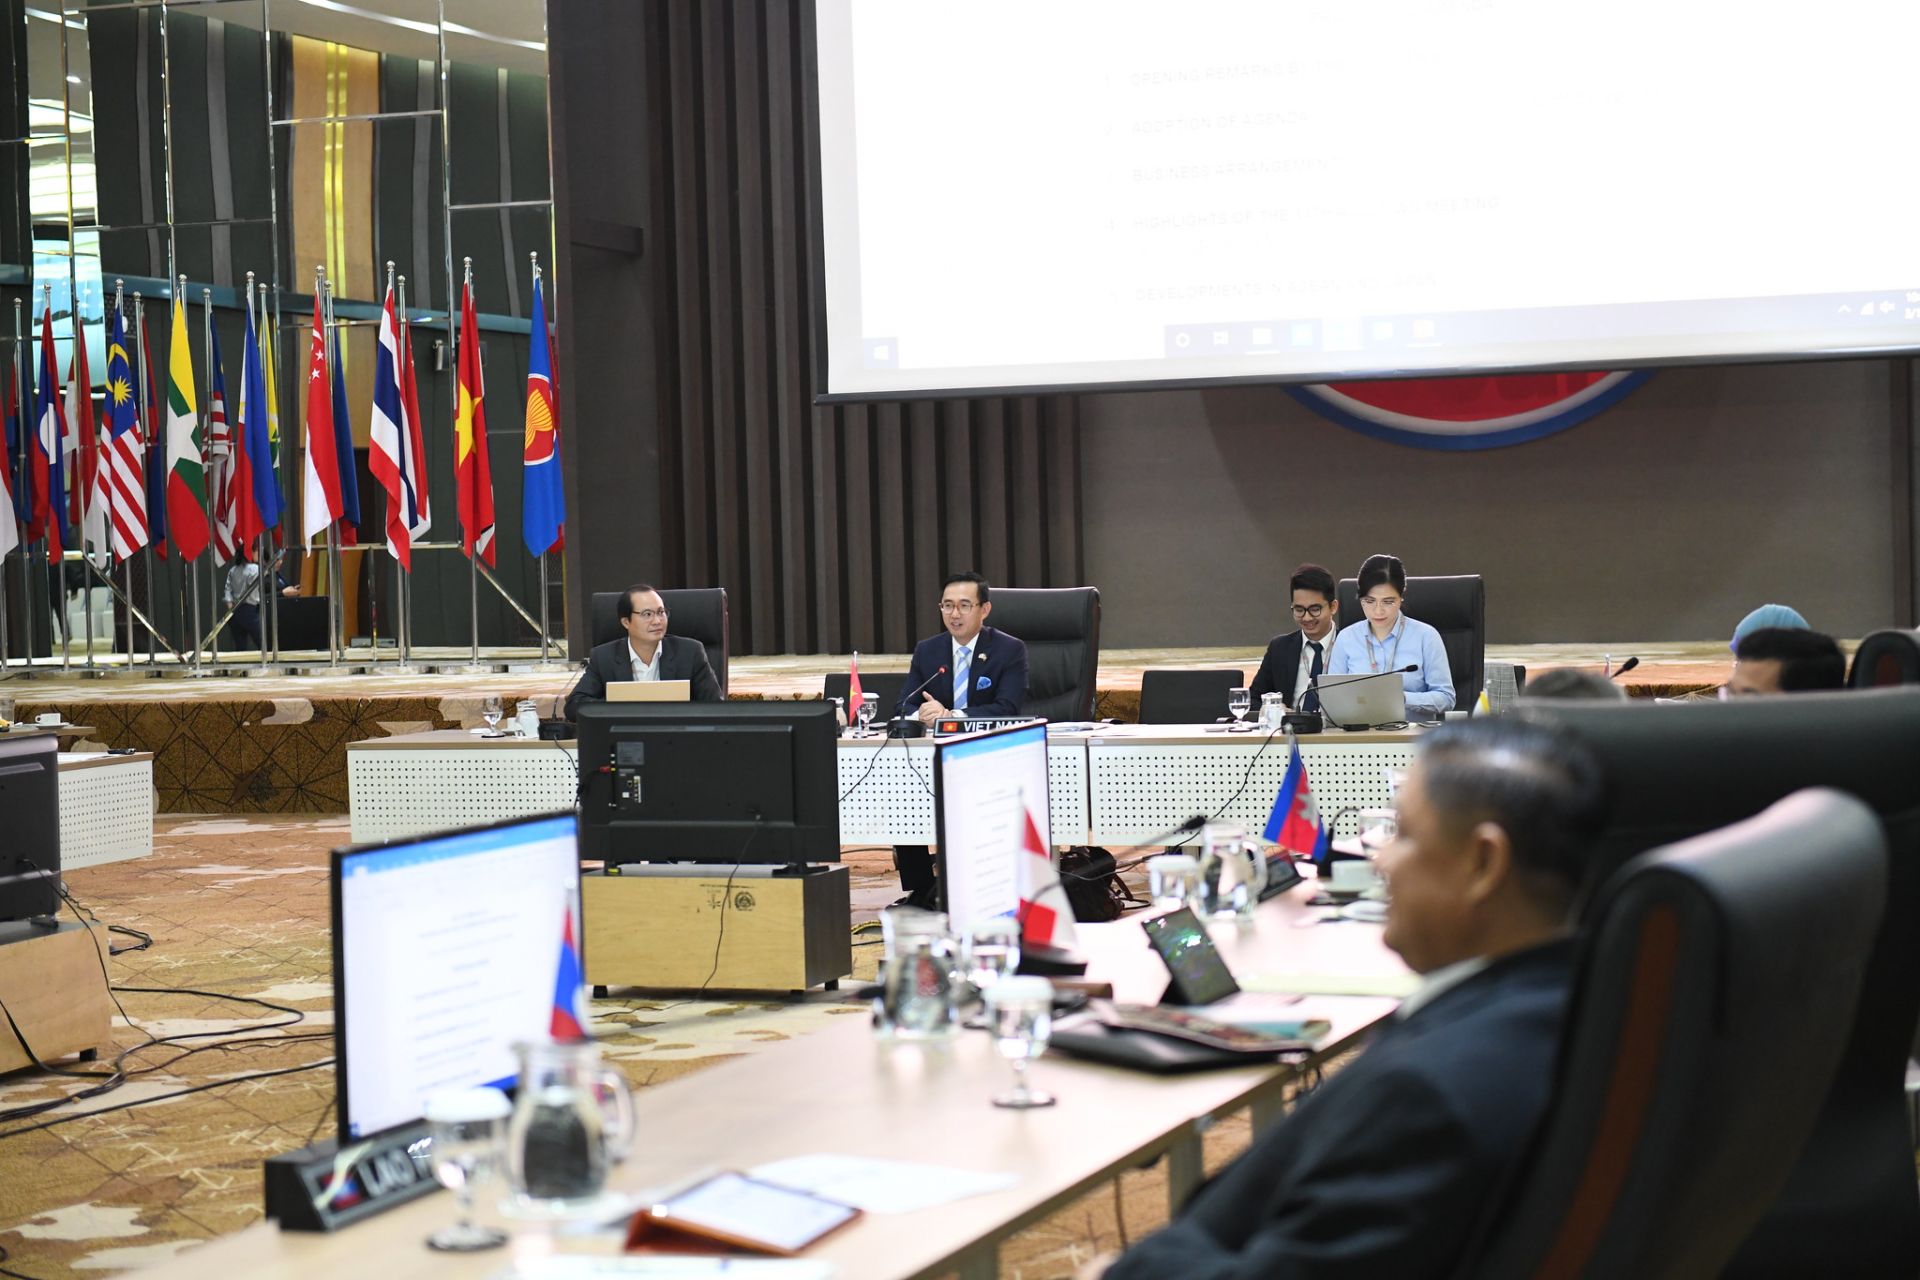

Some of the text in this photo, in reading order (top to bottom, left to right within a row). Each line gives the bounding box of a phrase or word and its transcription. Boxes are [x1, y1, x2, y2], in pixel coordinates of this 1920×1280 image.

[1130, 69, 1200, 87] OPENING
[1131, 115, 1213, 135] ADOPTION
[1131, 163, 1209, 183] BUSINESS
[1132, 209, 1227, 230] HIGHLIGHTS
[1135, 280, 1262, 302] DEVELOPMENTS
[964, 721, 992, 732] VIET
[357, 1147, 417, 1198] LAO
